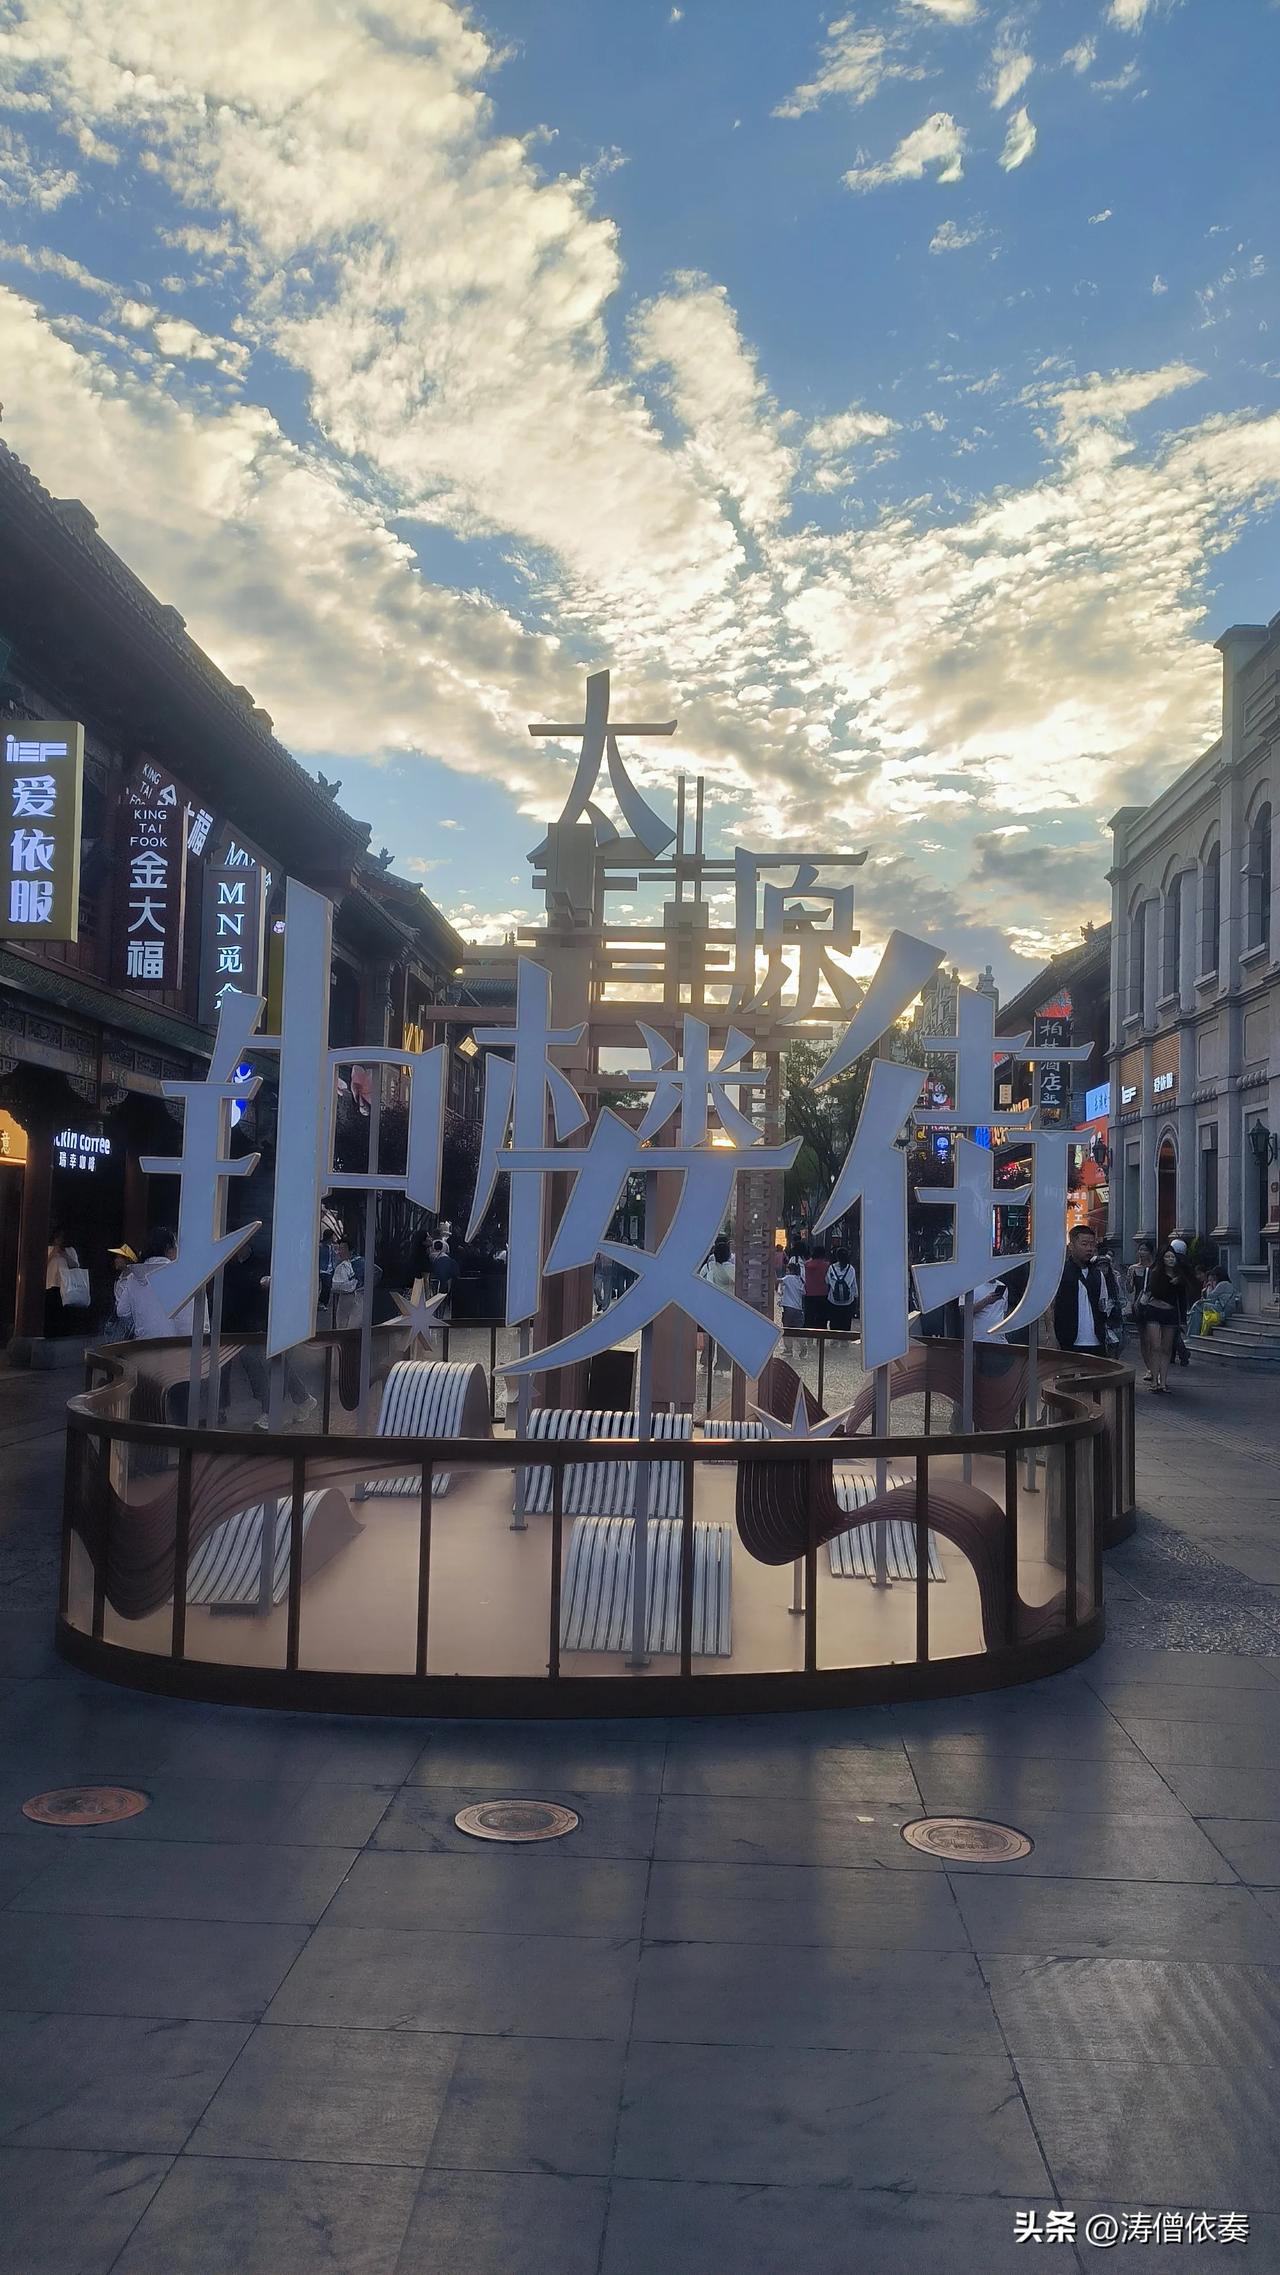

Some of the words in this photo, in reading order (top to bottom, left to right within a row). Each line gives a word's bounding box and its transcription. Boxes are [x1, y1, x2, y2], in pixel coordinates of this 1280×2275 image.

[142, 762, 162, 785] KING
[139, 781, 153, 799] TAI
[134, 810, 167, 820] KING
[139, 823, 162, 834] TAI
[8, 775, 57, 923] 爱依服
[130, 837, 168, 847] FOOK
[127, 850, 168, 979] 金大福
[59, 1151, 96, 1172] 瑞幸咖啡
